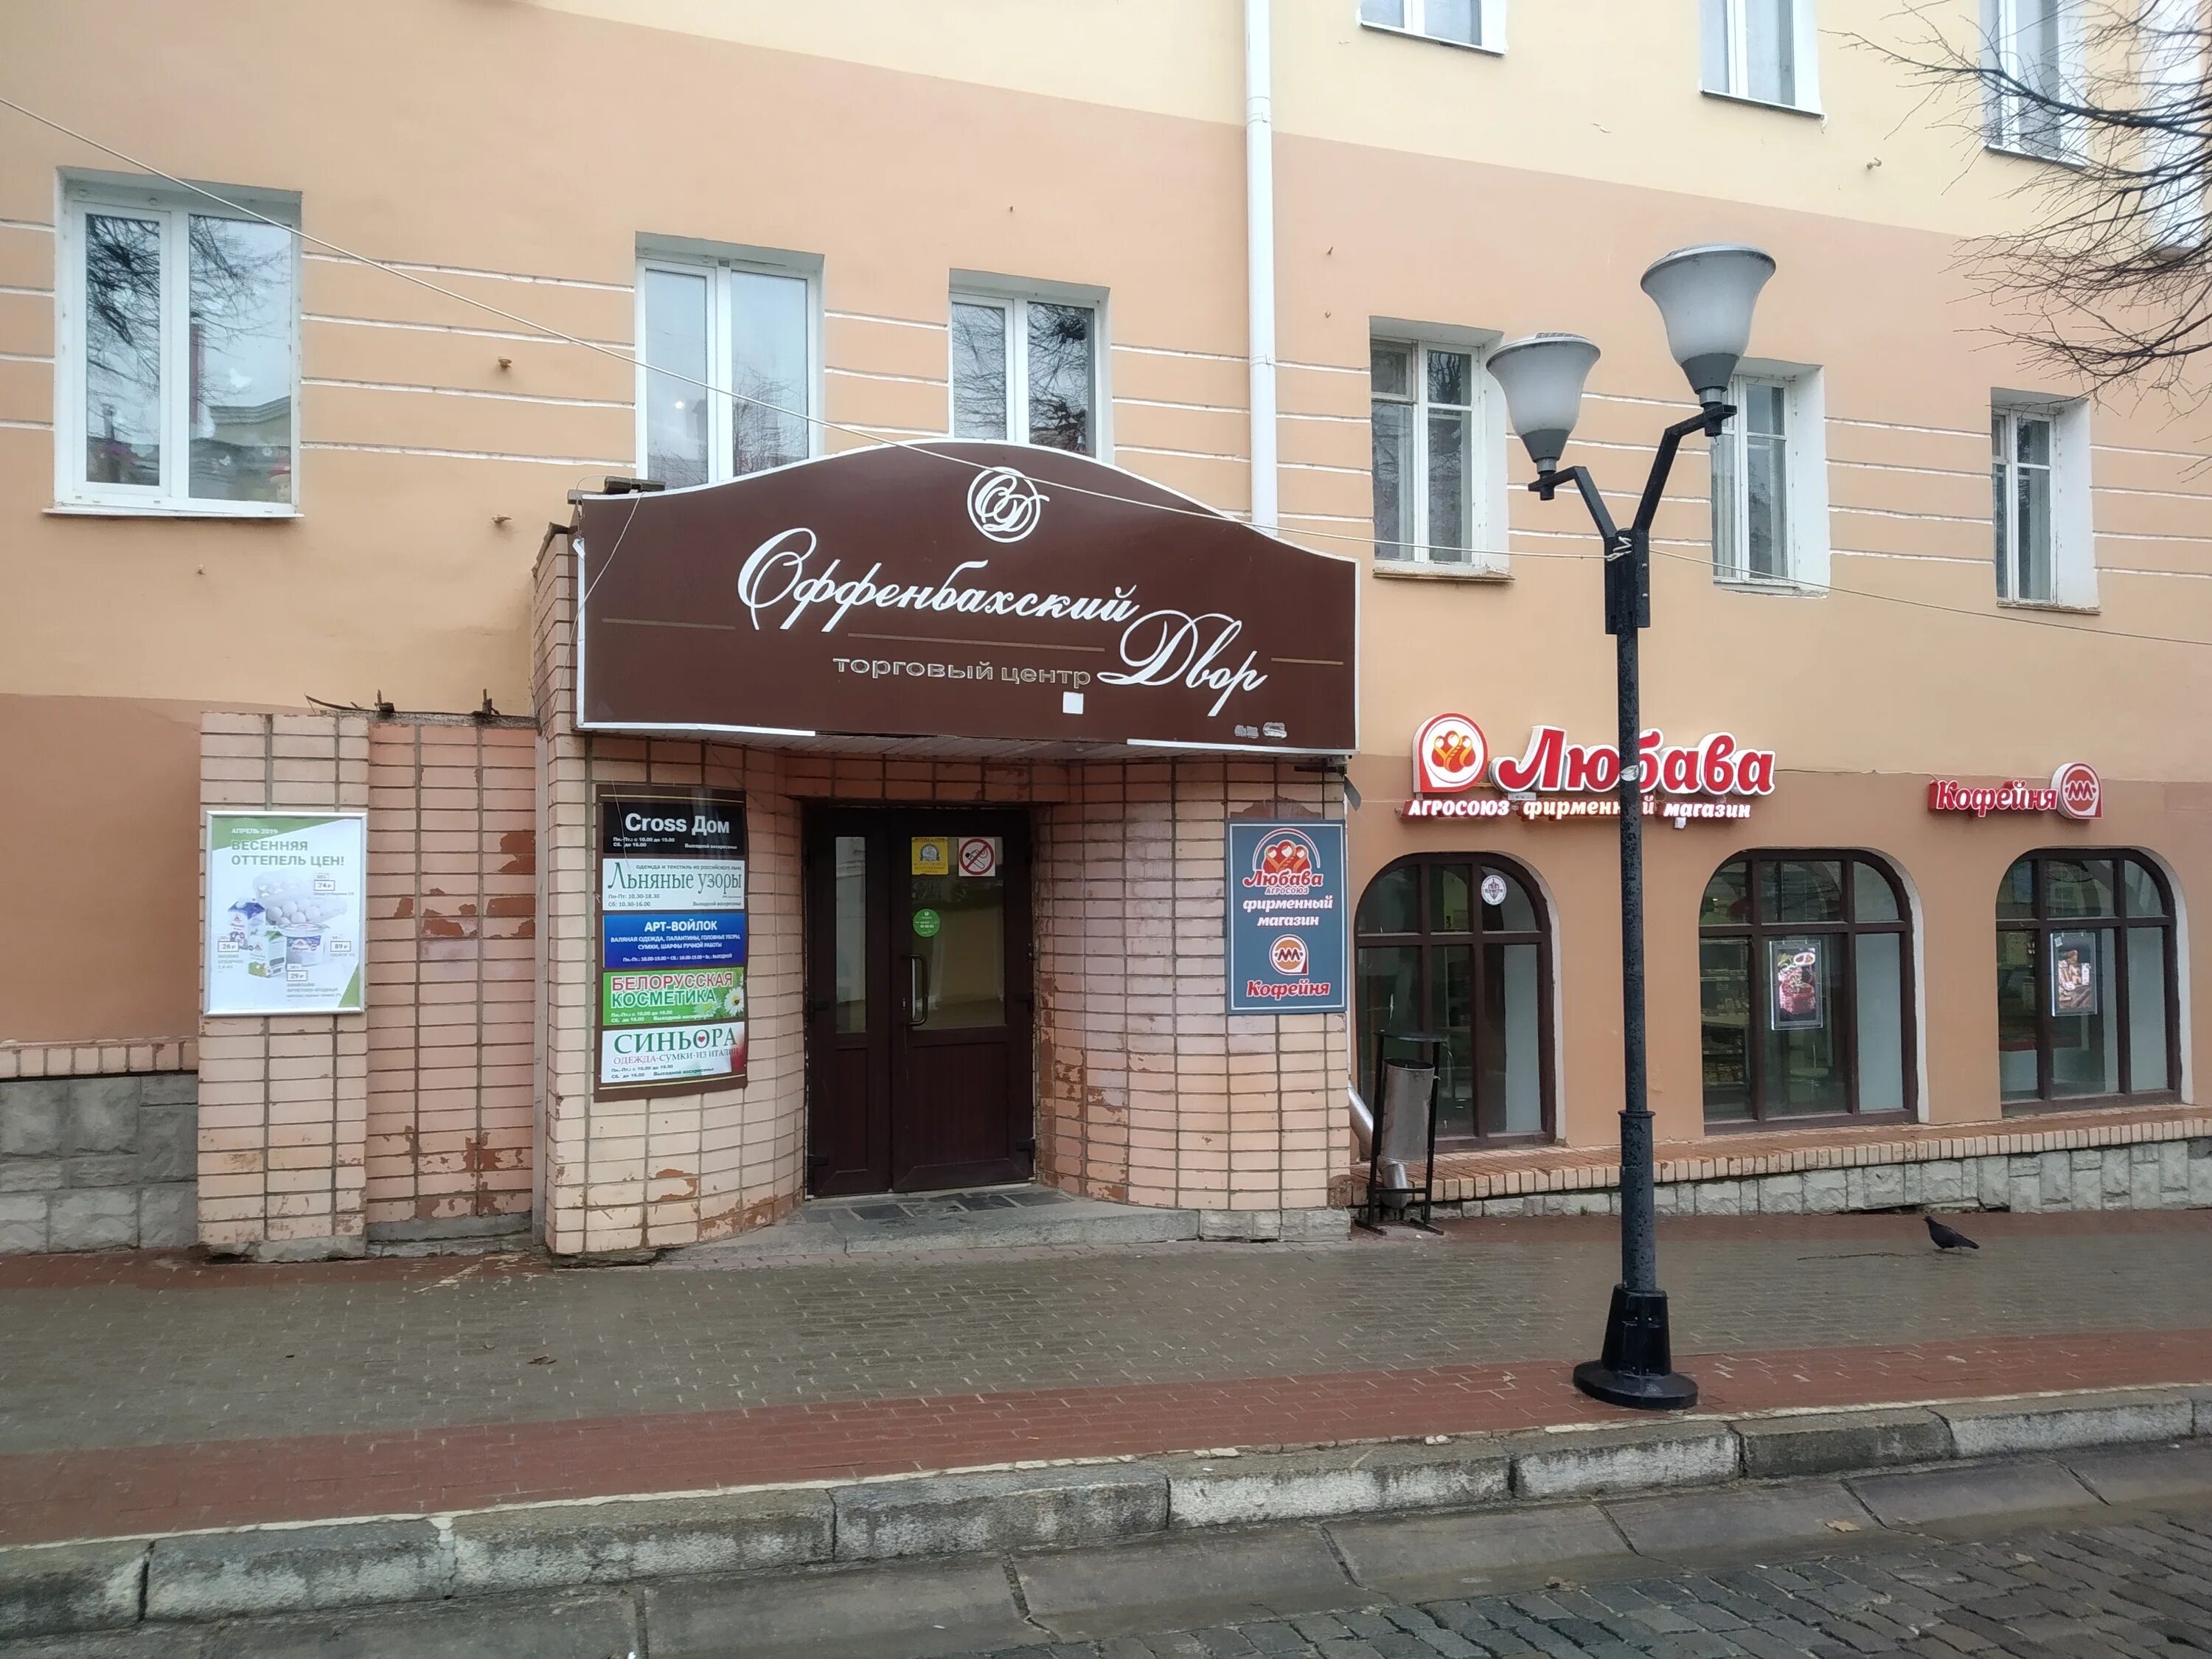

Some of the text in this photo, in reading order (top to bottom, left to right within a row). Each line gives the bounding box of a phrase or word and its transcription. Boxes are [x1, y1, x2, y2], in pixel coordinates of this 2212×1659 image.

[738, 526, 1143, 633] Оффенбахский
[832, 658, 1091, 689] торговый центр
[1096, 610, 1268, 717] Двор
[1408, 795, 1751, 819] АГРОСОЮЗ фирменнй магазин
[1935, 779, 2059, 818] Кофейня
[625, 813, 729, 836] Cross Дом
[232, 841, 308, 851] ВЕСЕННЯЯ
[231, 855, 344, 868] ОТТЕПЕЛЬ ЦЕН!
[608, 862, 742, 894] Льняные узоры
[1242, 868, 1324, 888] Любава
[1265, 886, 1310, 895] АГРОСОЮЗ
[1242, 894, 1334, 913] фирменный
[644, 919, 717, 932] АРТ-ВОЙЛОК
[1256, 916, 1319, 927] магазин
[611, 972, 733, 992] БЕЛОРУССКАЯ
[1246, 978, 1331, 1001] Кофейня
[611, 989, 716, 1009] КОСМЕТИКА
[614, 1027, 737, 1054] СИНЬОРА
